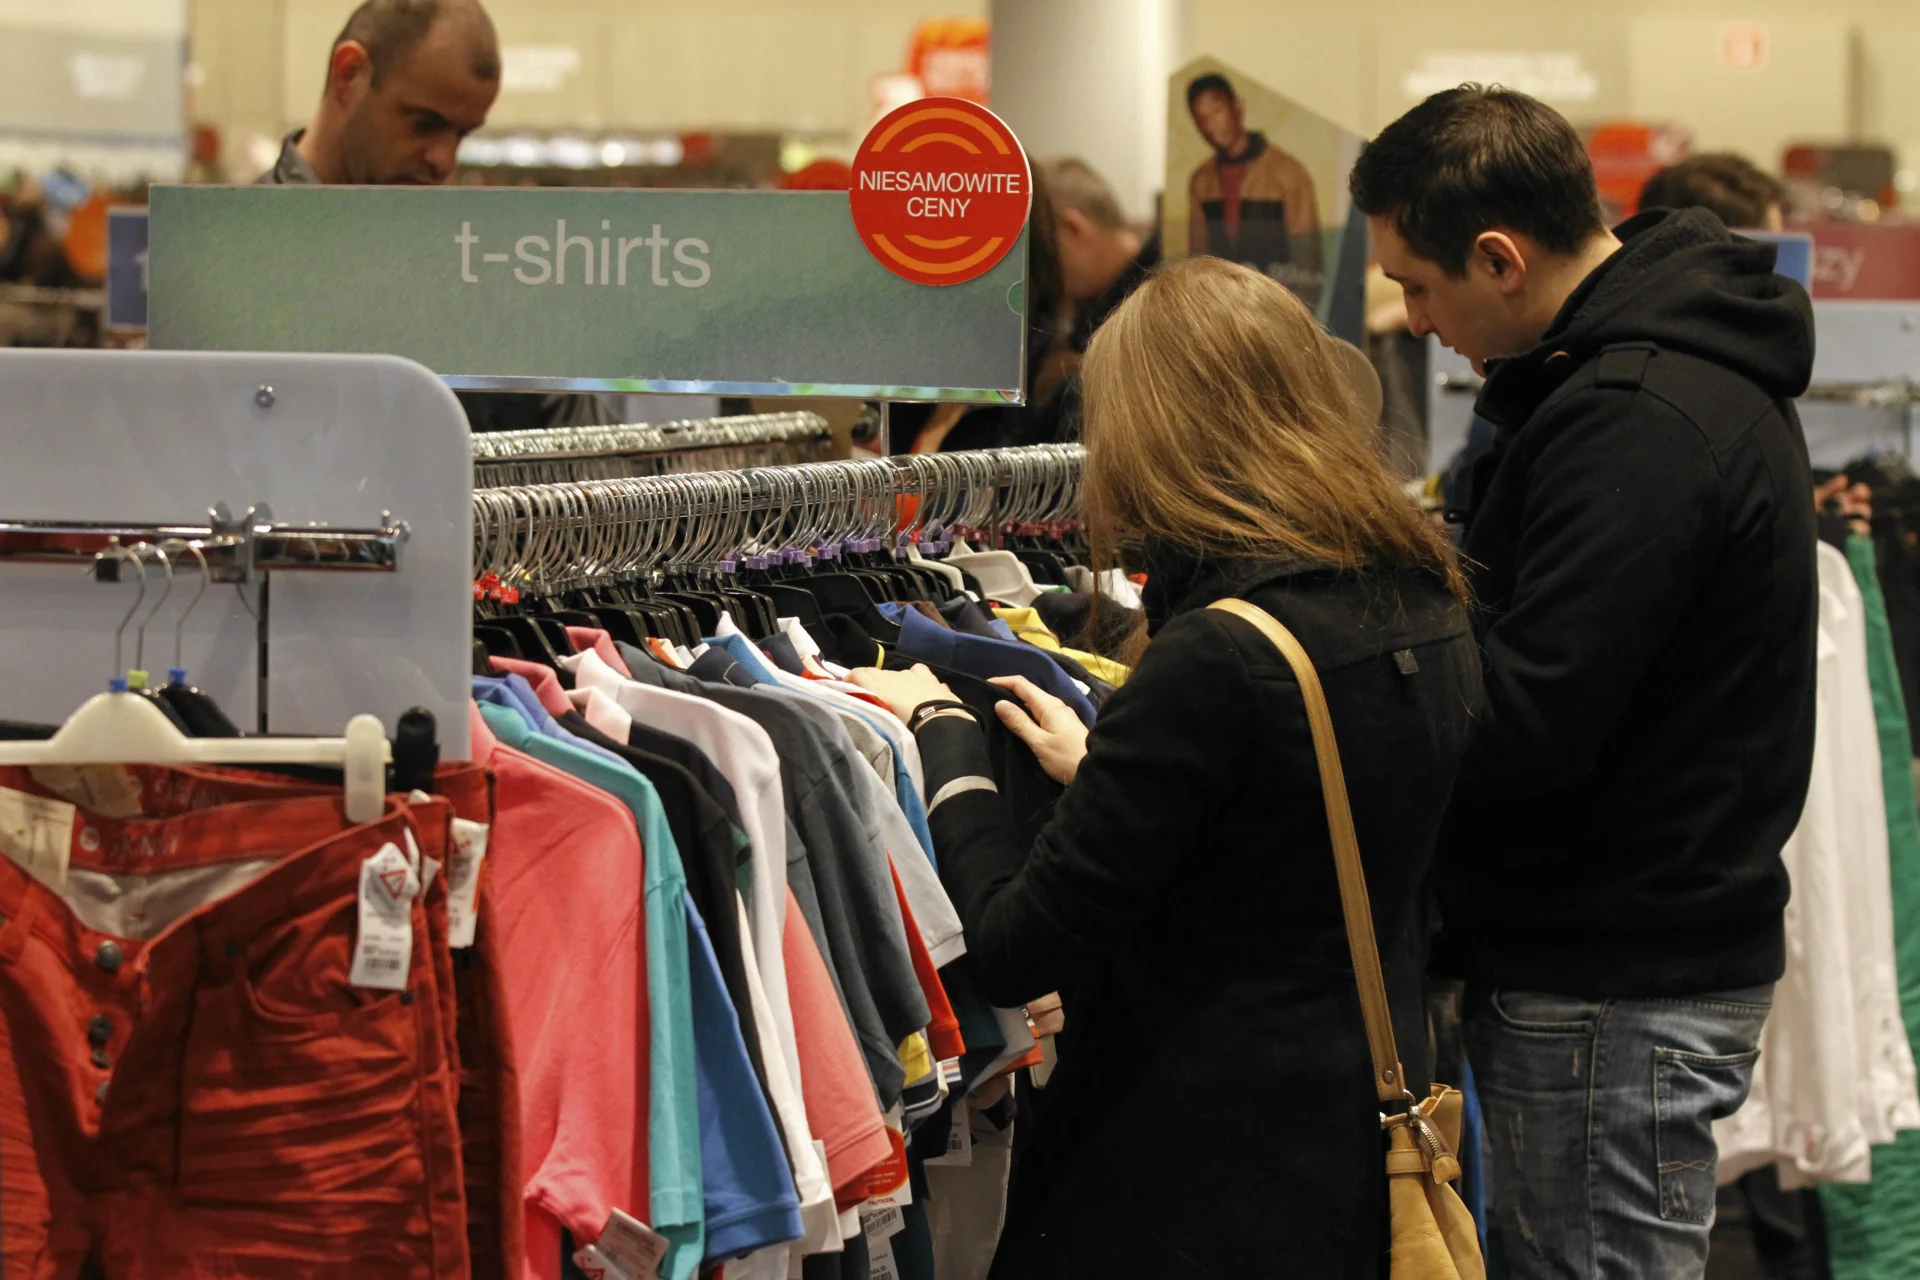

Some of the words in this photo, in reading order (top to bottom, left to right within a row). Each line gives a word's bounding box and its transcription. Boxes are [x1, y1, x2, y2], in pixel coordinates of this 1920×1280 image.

[859, 170, 1021, 194] NIESAMOWITE
[906, 196, 971, 218] CENY
[454, 219, 712, 288] t-shirts
